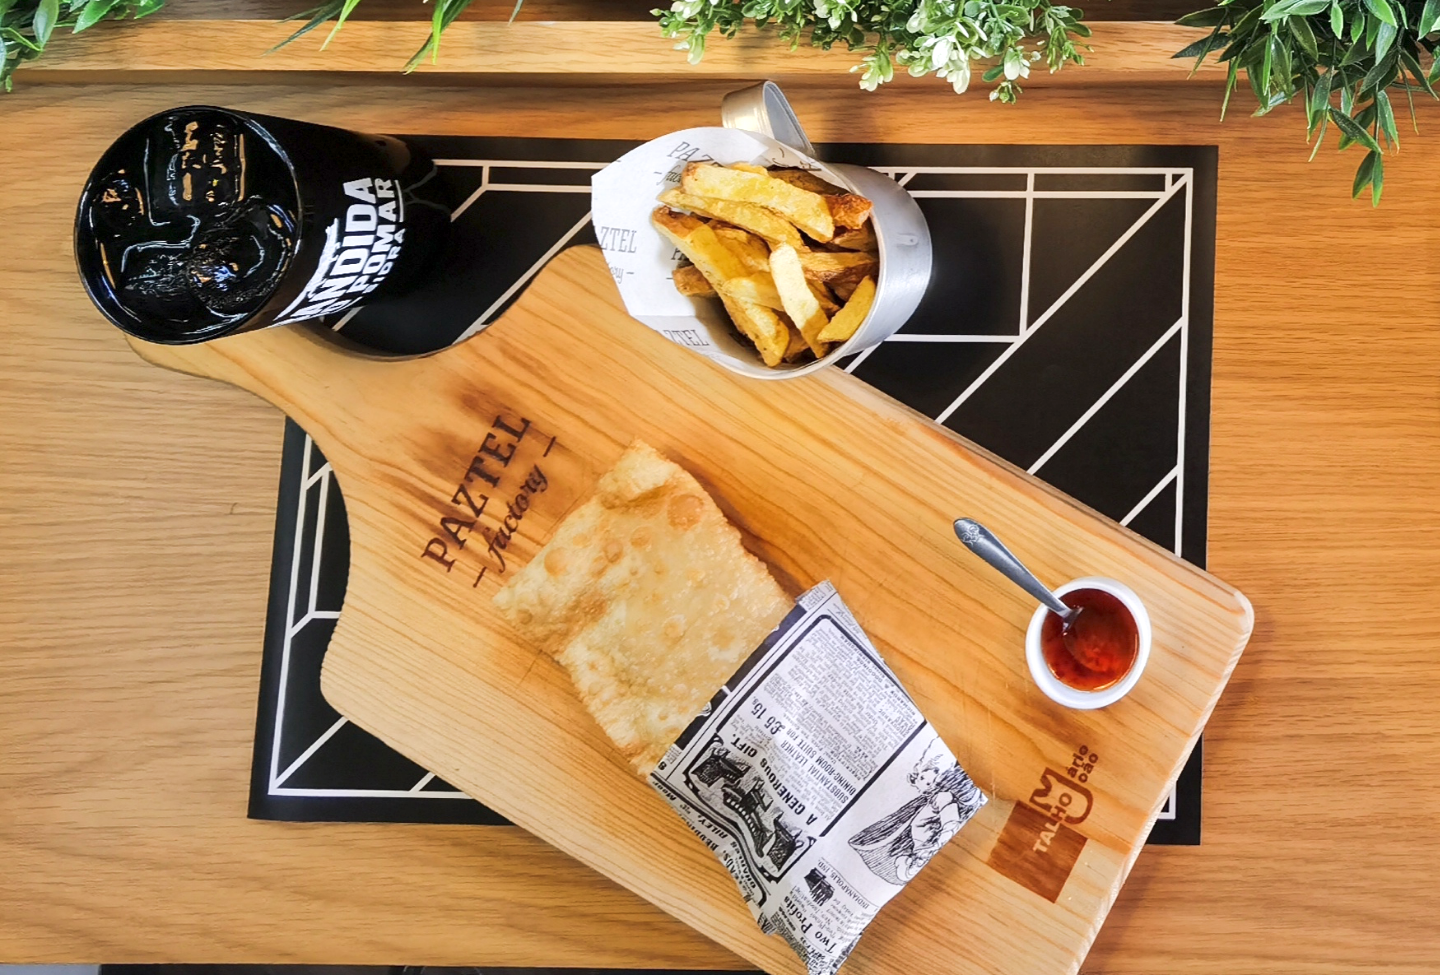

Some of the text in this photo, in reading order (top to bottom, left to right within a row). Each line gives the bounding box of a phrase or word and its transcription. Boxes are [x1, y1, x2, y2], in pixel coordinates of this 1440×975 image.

[346, 178, 395, 294] POMAR
[421, 415, 532, 573] PAZTEL
[483, 464, 548, 574] factory
[727, 732, 817, 826] A GENEROUS GIFT.
[780, 739, 849, 804] SUBSTANTIAL LEATHER
[785, 727, 857, 795] DINING-ROOM SUITE FOR
[1032, 792, 1072, 853] TALHO
[779, 895, 812, 932] Profits
[826, 869, 869, 910] INDIANAPOLIS,
[811, 928, 838, 954] Two
